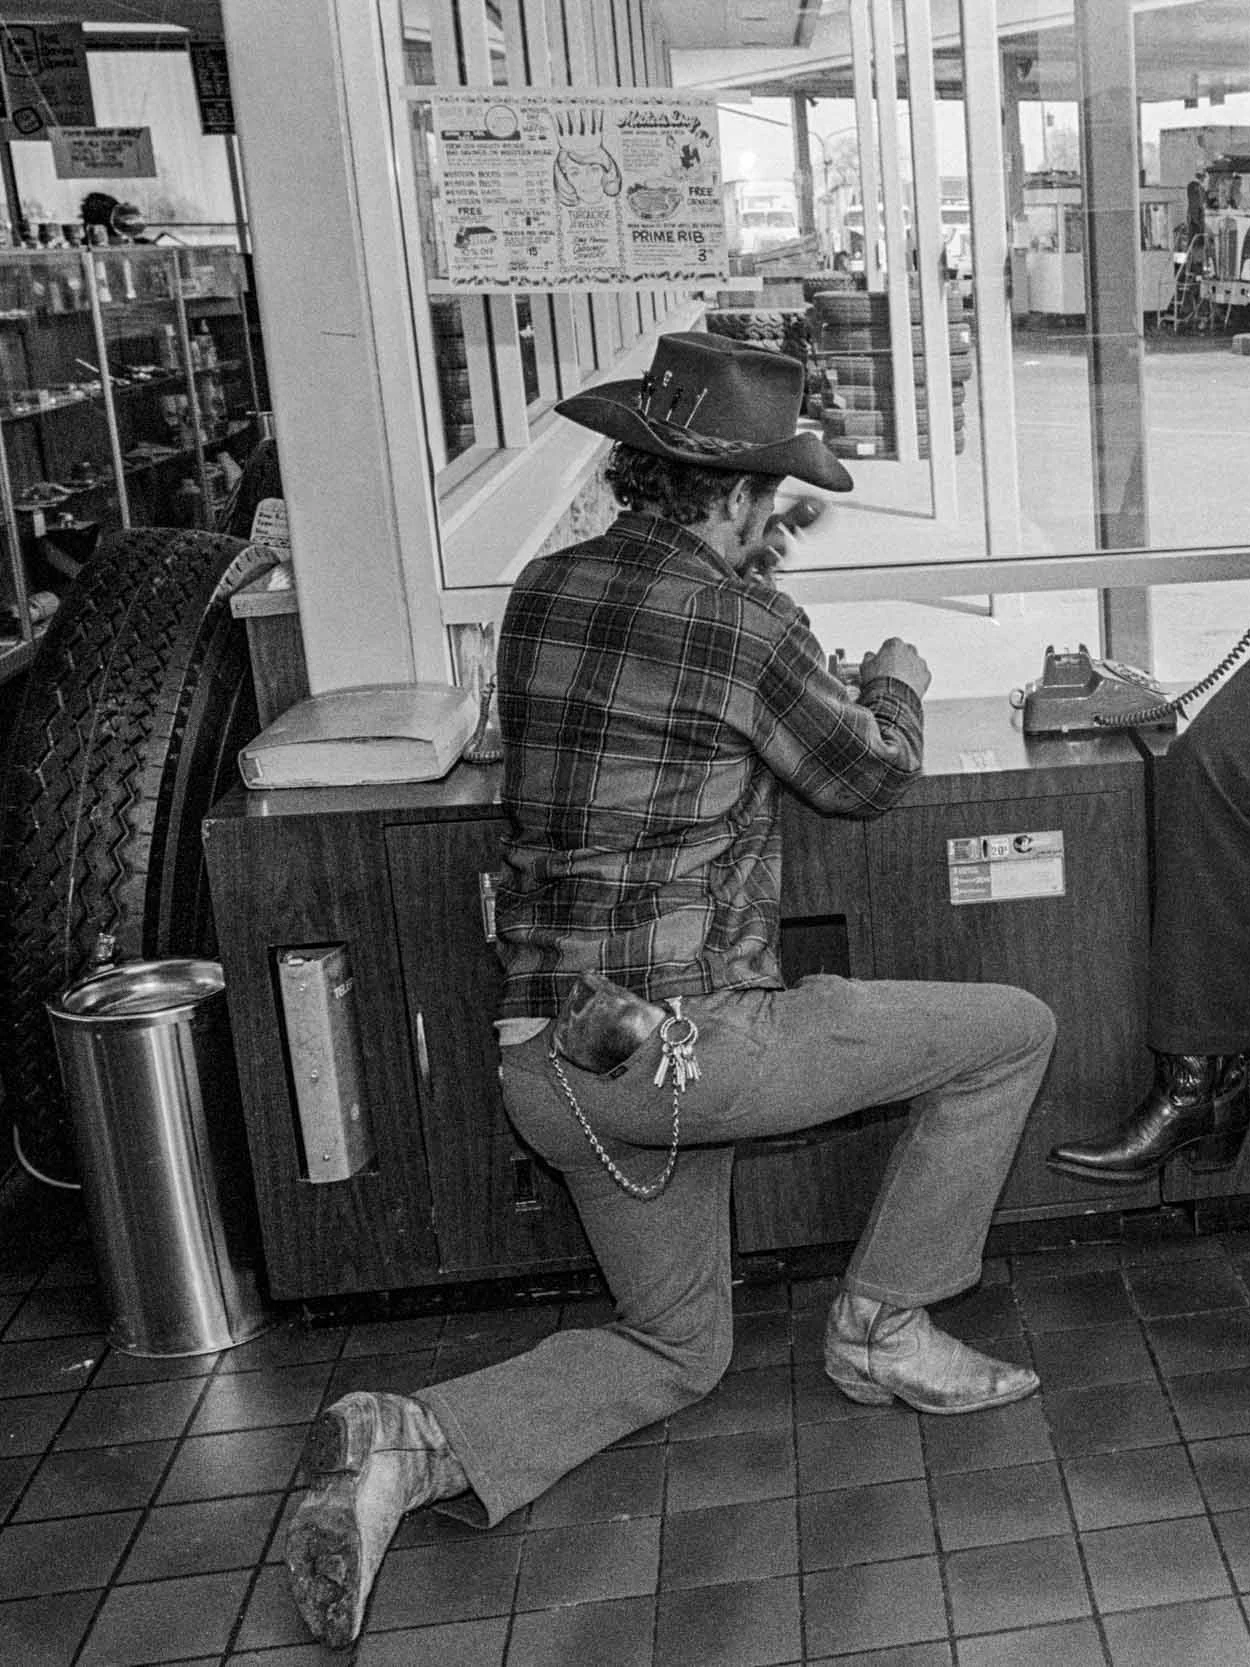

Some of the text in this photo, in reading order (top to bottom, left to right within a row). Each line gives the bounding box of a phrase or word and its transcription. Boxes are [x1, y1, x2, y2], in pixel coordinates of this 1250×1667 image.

[688, 186, 714, 197] FREE
[458, 207, 482, 215] FREE
[632, 230, 706, 246] PRIME RIB
